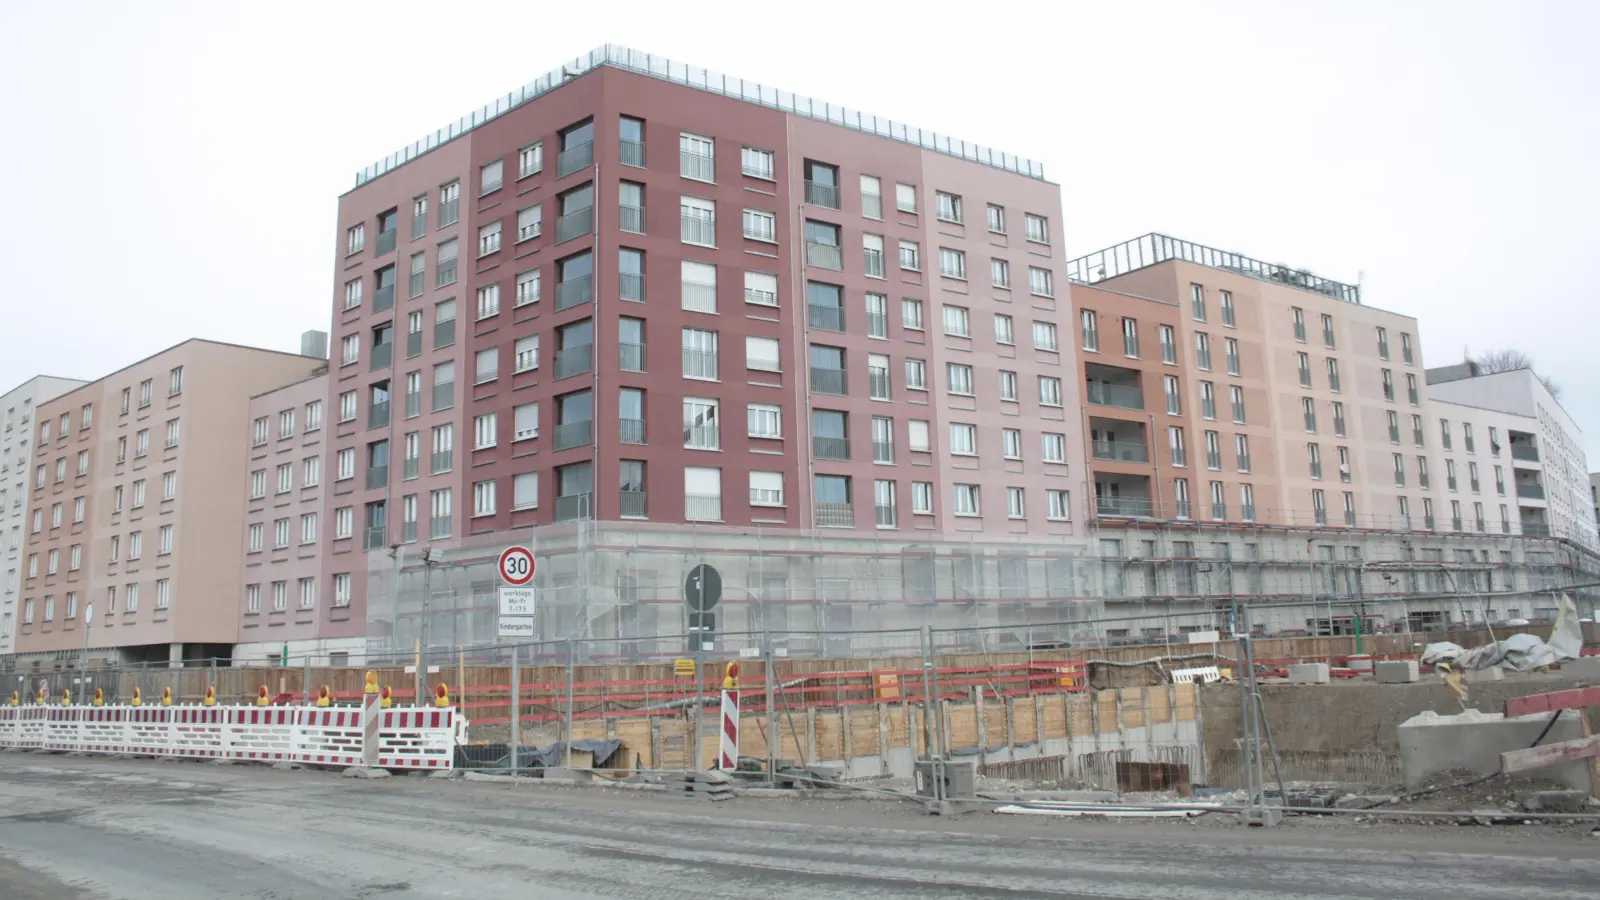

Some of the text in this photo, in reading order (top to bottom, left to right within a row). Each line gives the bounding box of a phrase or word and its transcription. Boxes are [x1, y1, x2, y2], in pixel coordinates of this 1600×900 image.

[507, 557, 527, 574] 30
[504, 590, 531, 598] werktags
[500, 623, 532, 631] Kindergarten
